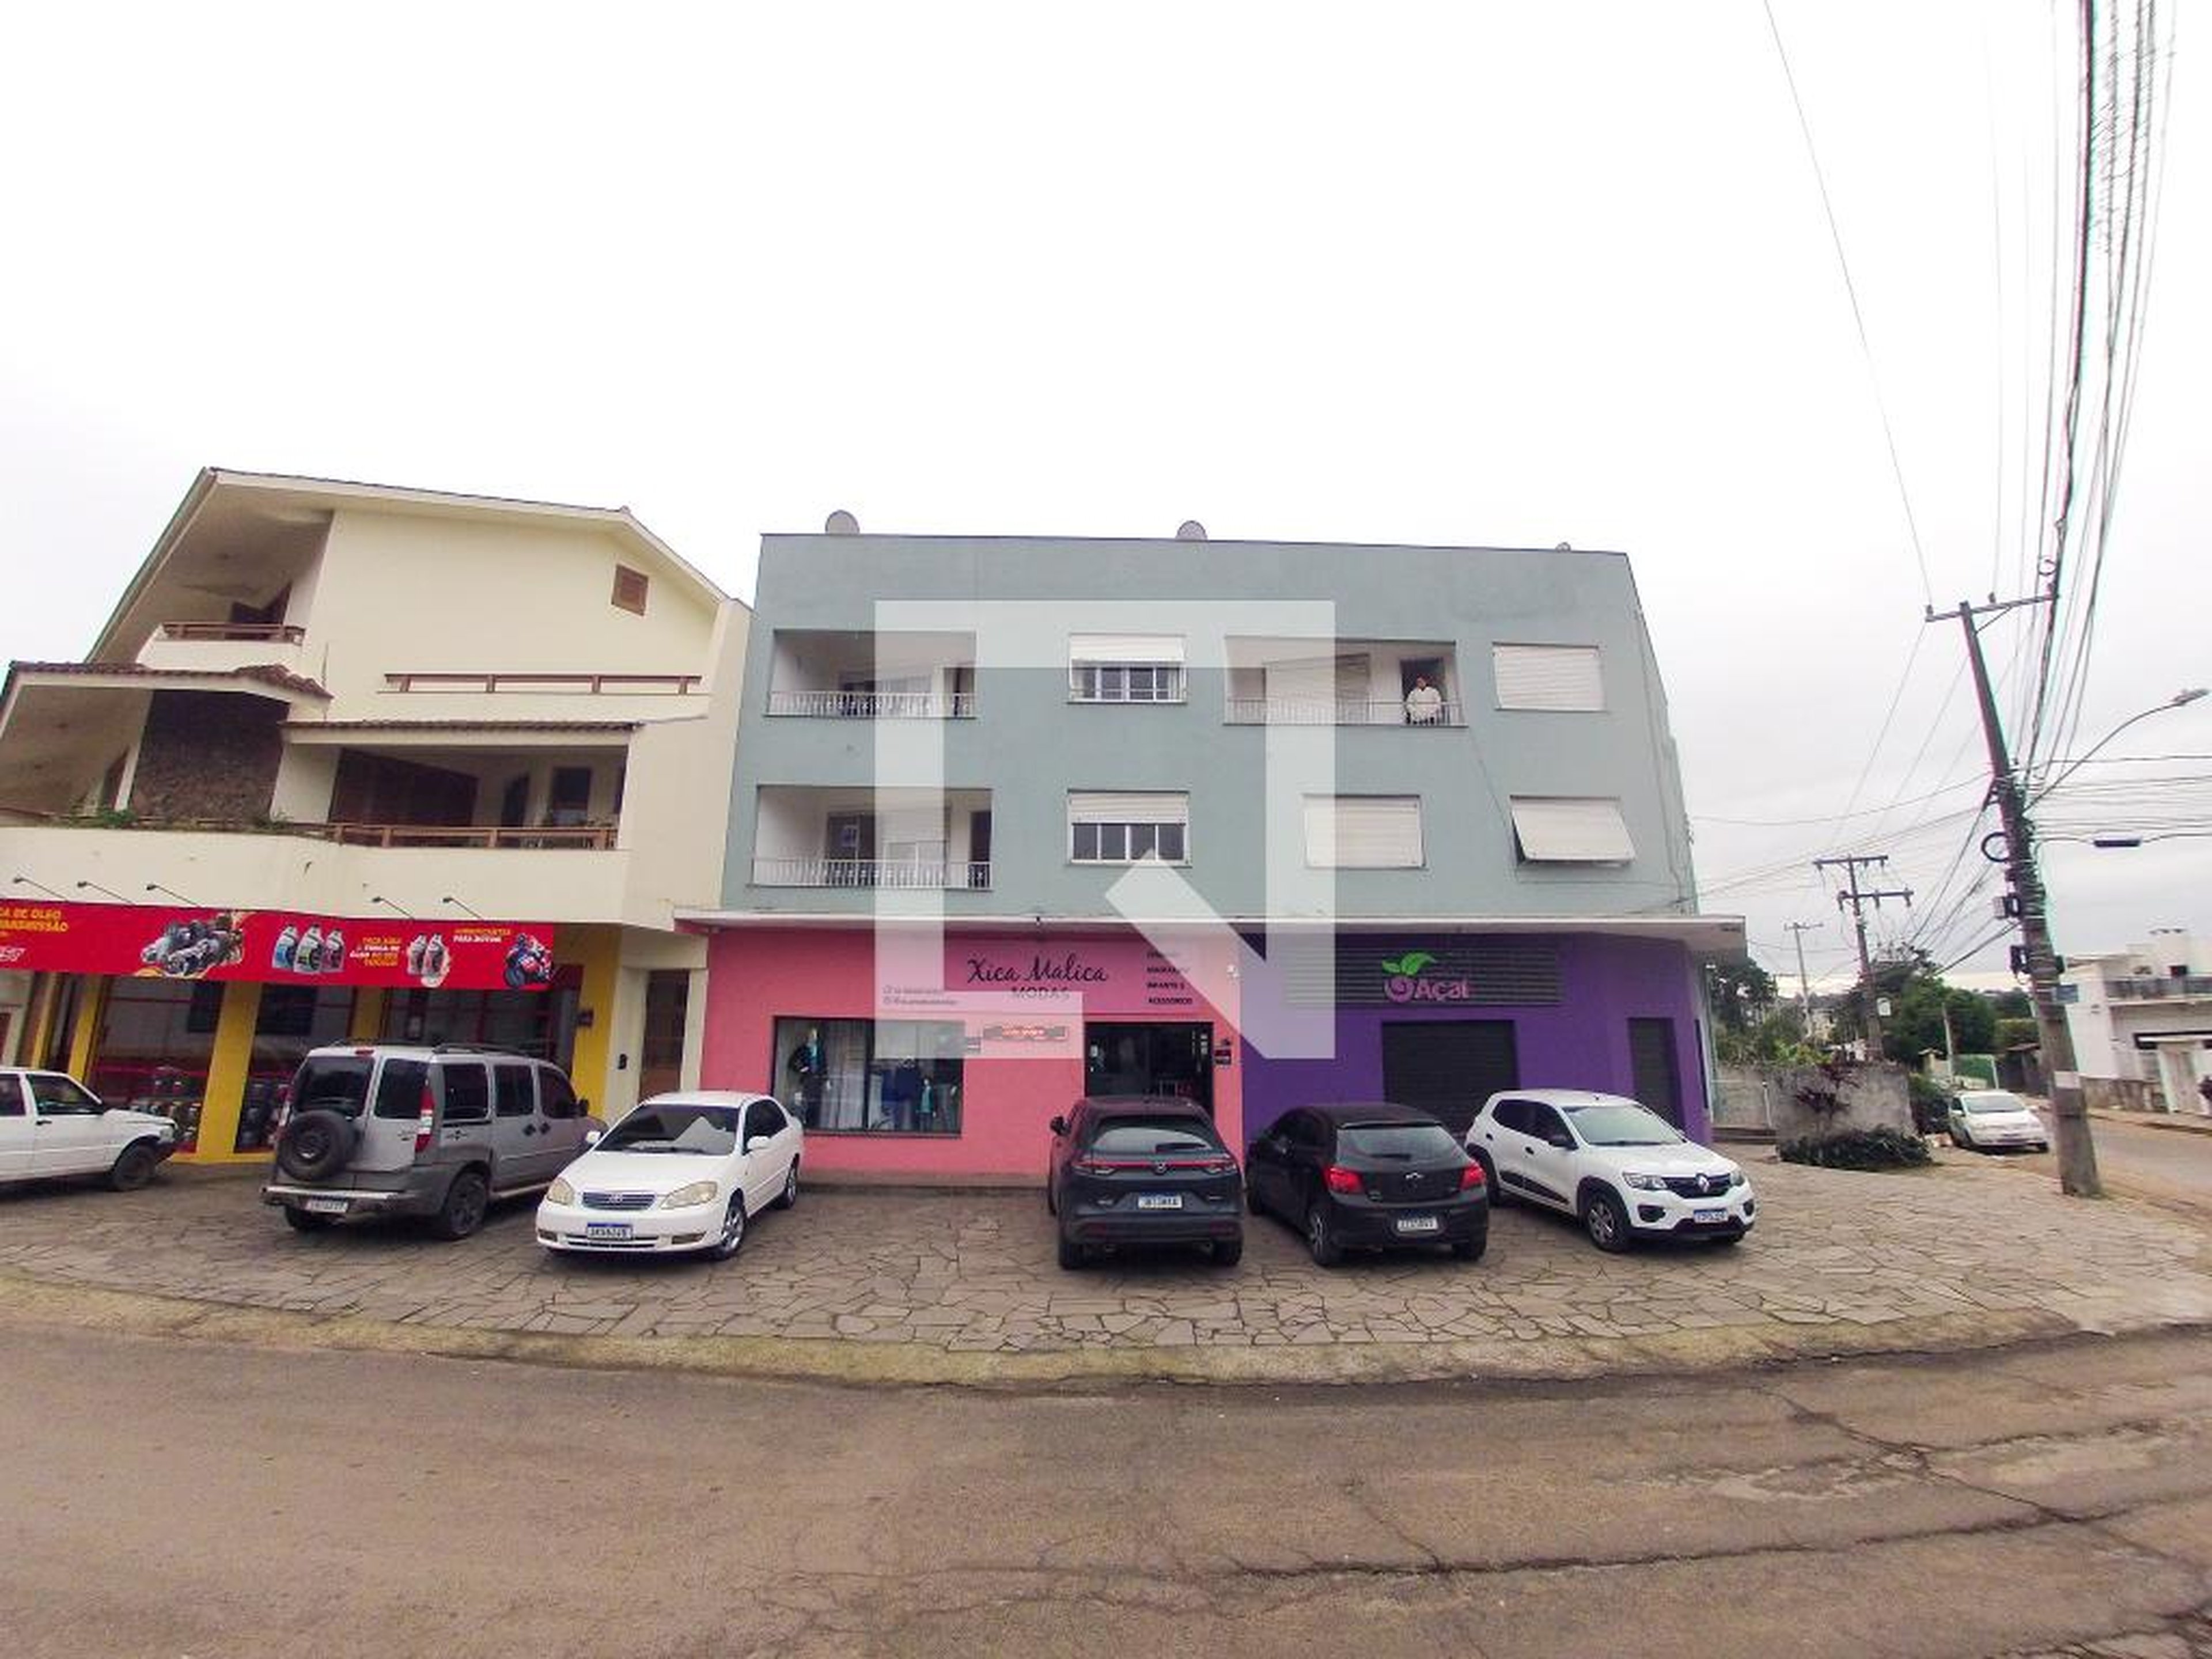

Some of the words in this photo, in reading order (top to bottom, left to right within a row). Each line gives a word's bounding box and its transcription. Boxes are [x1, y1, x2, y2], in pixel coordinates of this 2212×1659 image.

[967, 958, 1021, 983] Xica
[1024, 953, 1109, 982] Malica
[1011, 986, 1070, 1001] MODAS
